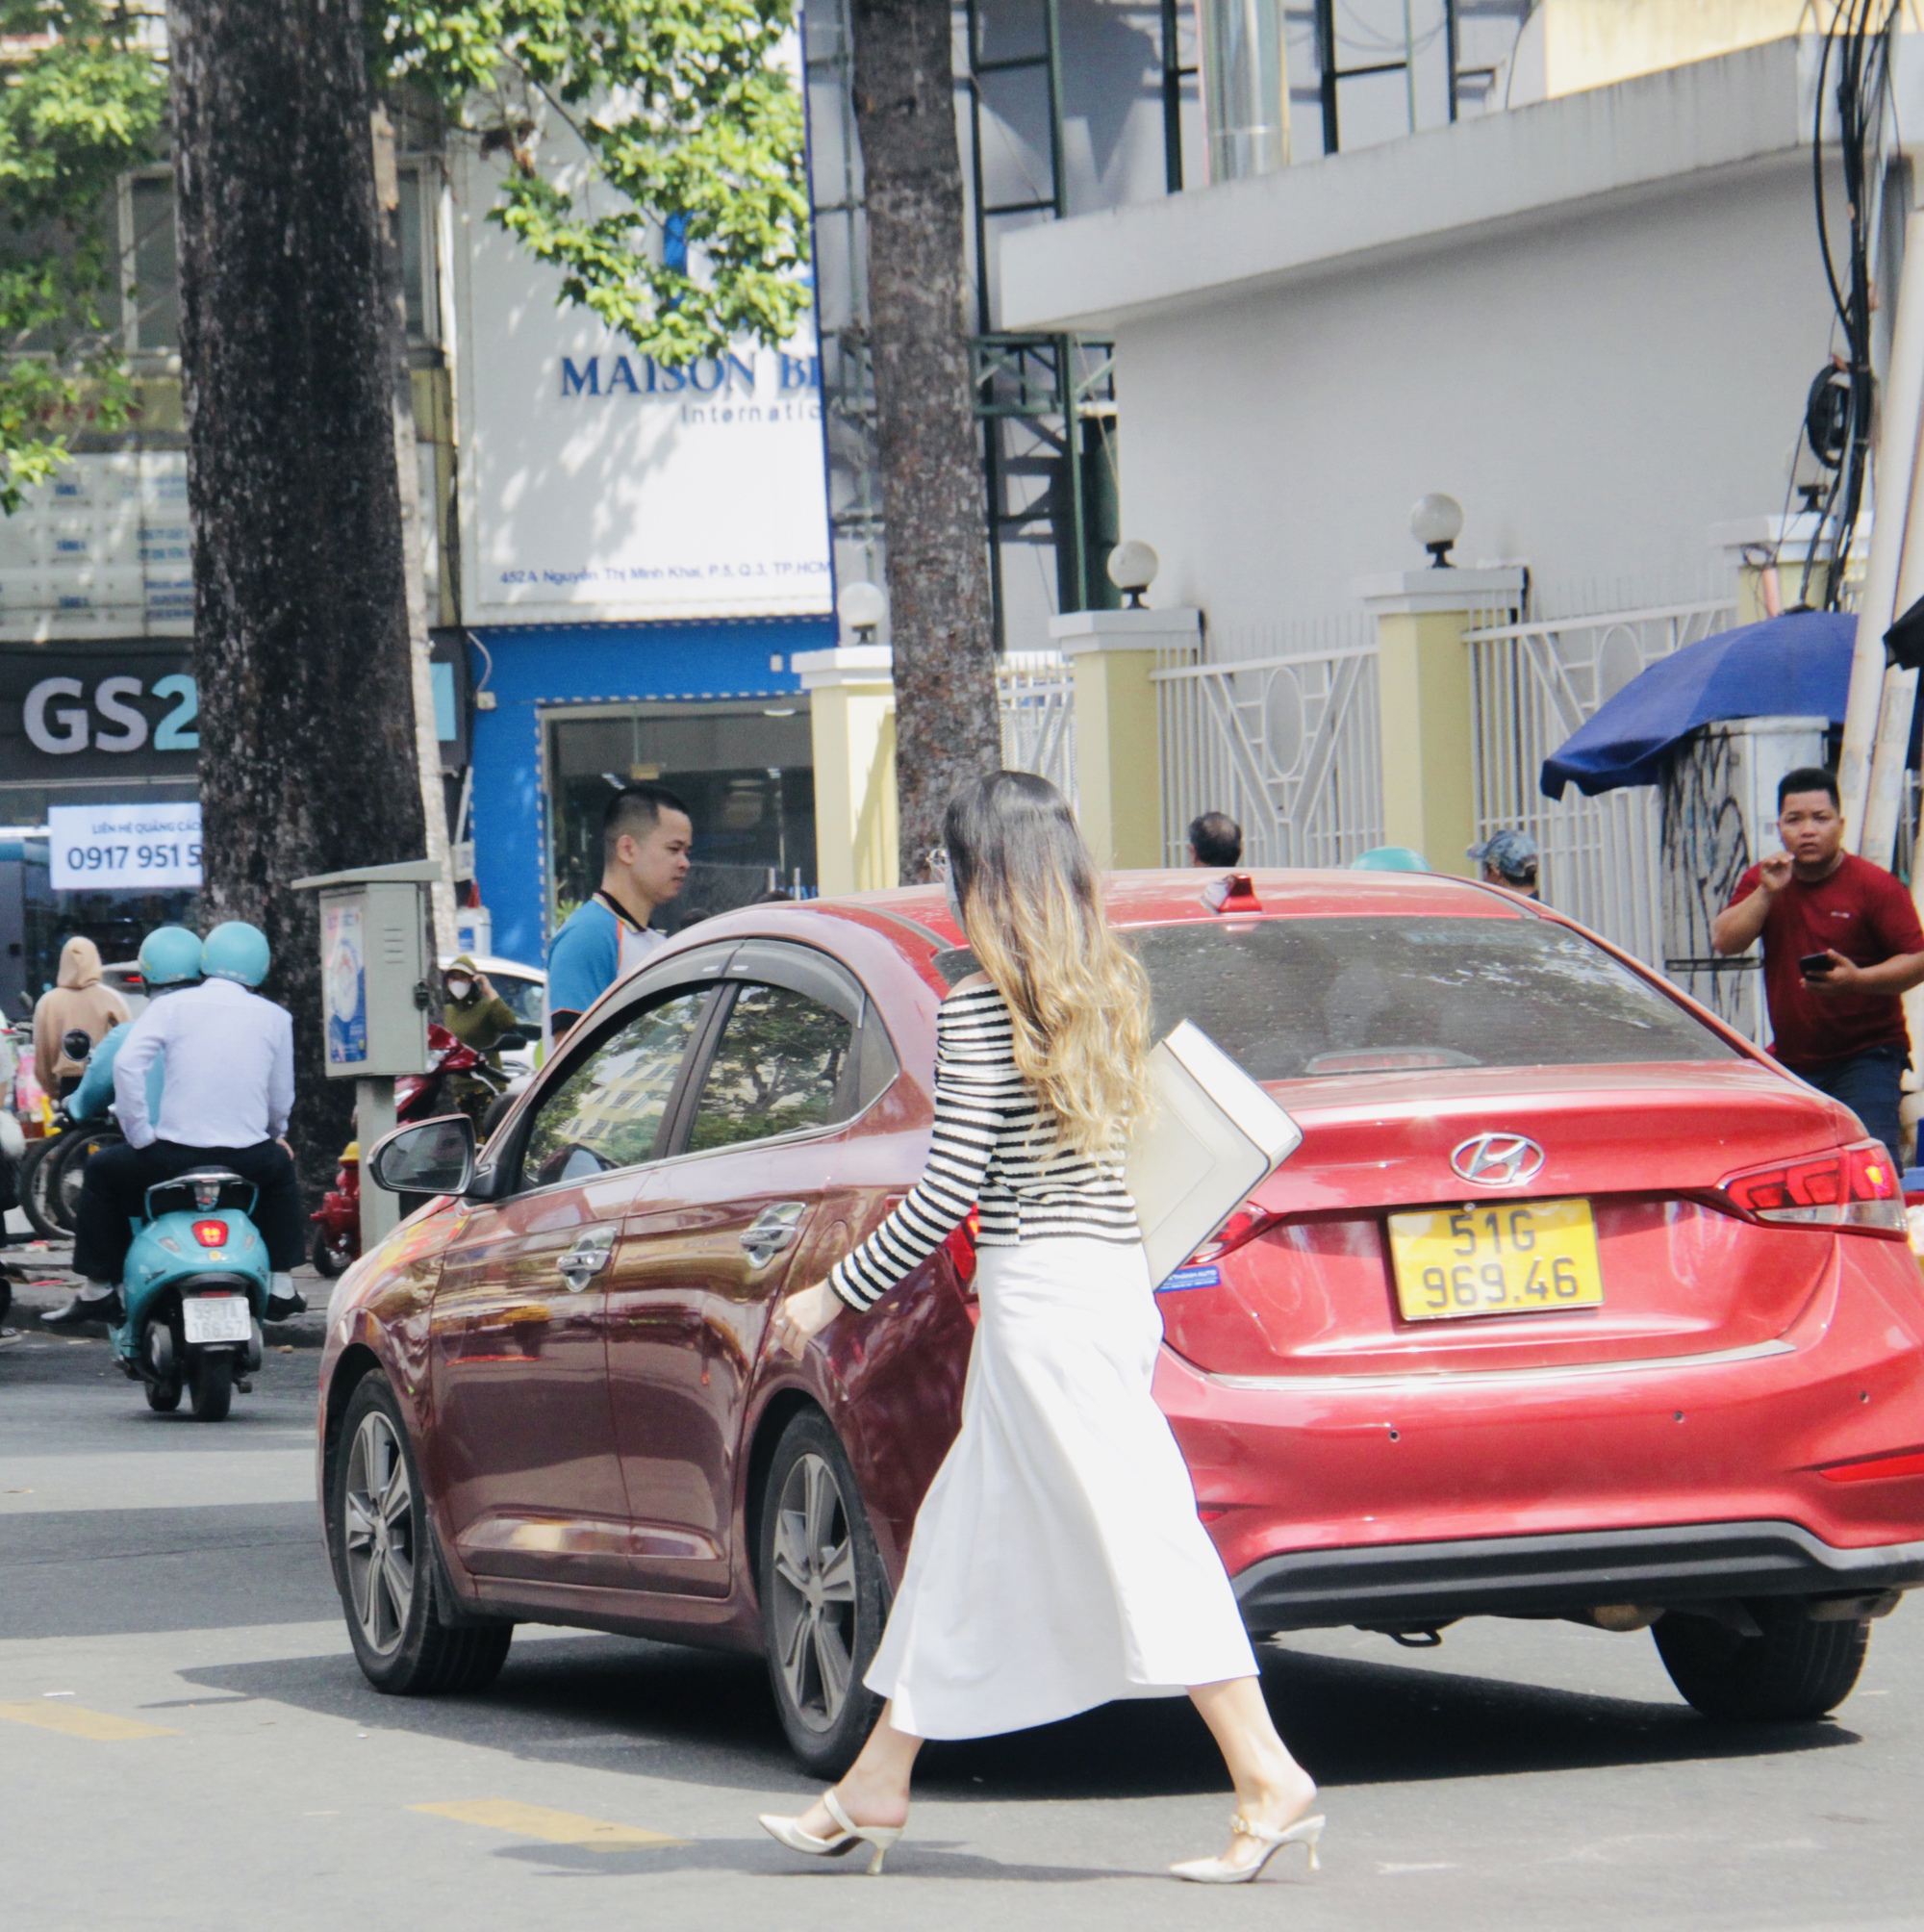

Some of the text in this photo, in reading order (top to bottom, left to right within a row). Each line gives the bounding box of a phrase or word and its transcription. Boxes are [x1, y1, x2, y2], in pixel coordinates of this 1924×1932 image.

[561, 352, 756, 396] MAISON
[23, 674, 200, 755] GS2
[67, 845, 129, 871] 0917
[137, 843, 180, 868] 951
[1449, 1209, 1535, 1257] 51G
[1422, 1257, 1579, 1309] 969.46
